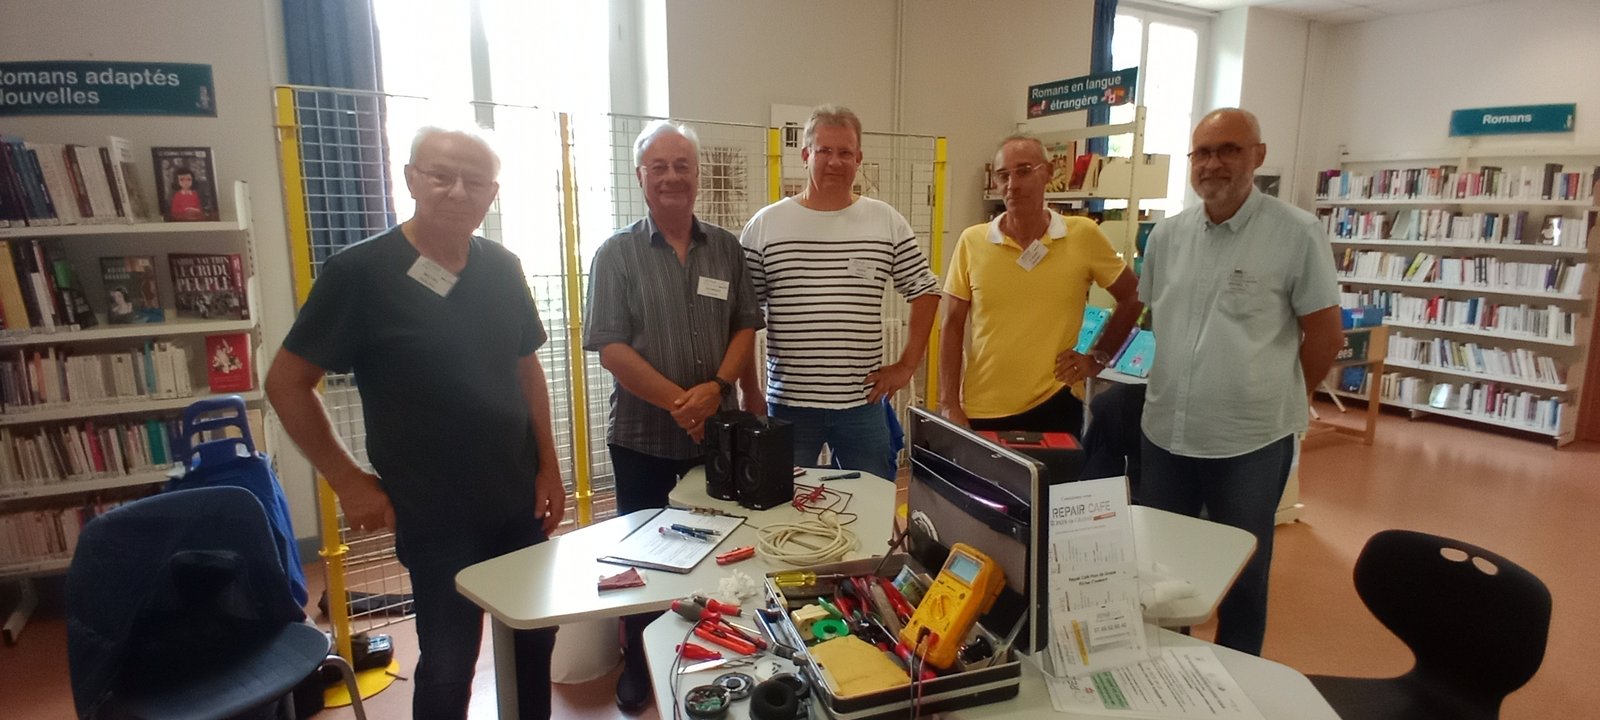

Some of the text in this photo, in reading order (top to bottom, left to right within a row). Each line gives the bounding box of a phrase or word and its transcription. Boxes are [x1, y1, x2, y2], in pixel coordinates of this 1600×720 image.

[85, 68, 180, 89] adaptés
[1032, 76, 1121, 98] Romans en langue
[1050, 95, 1097, 110] étrangère
[1482, 114, 1531, 125] Romans
[1052, 504, 1085, 519] REPAIR
